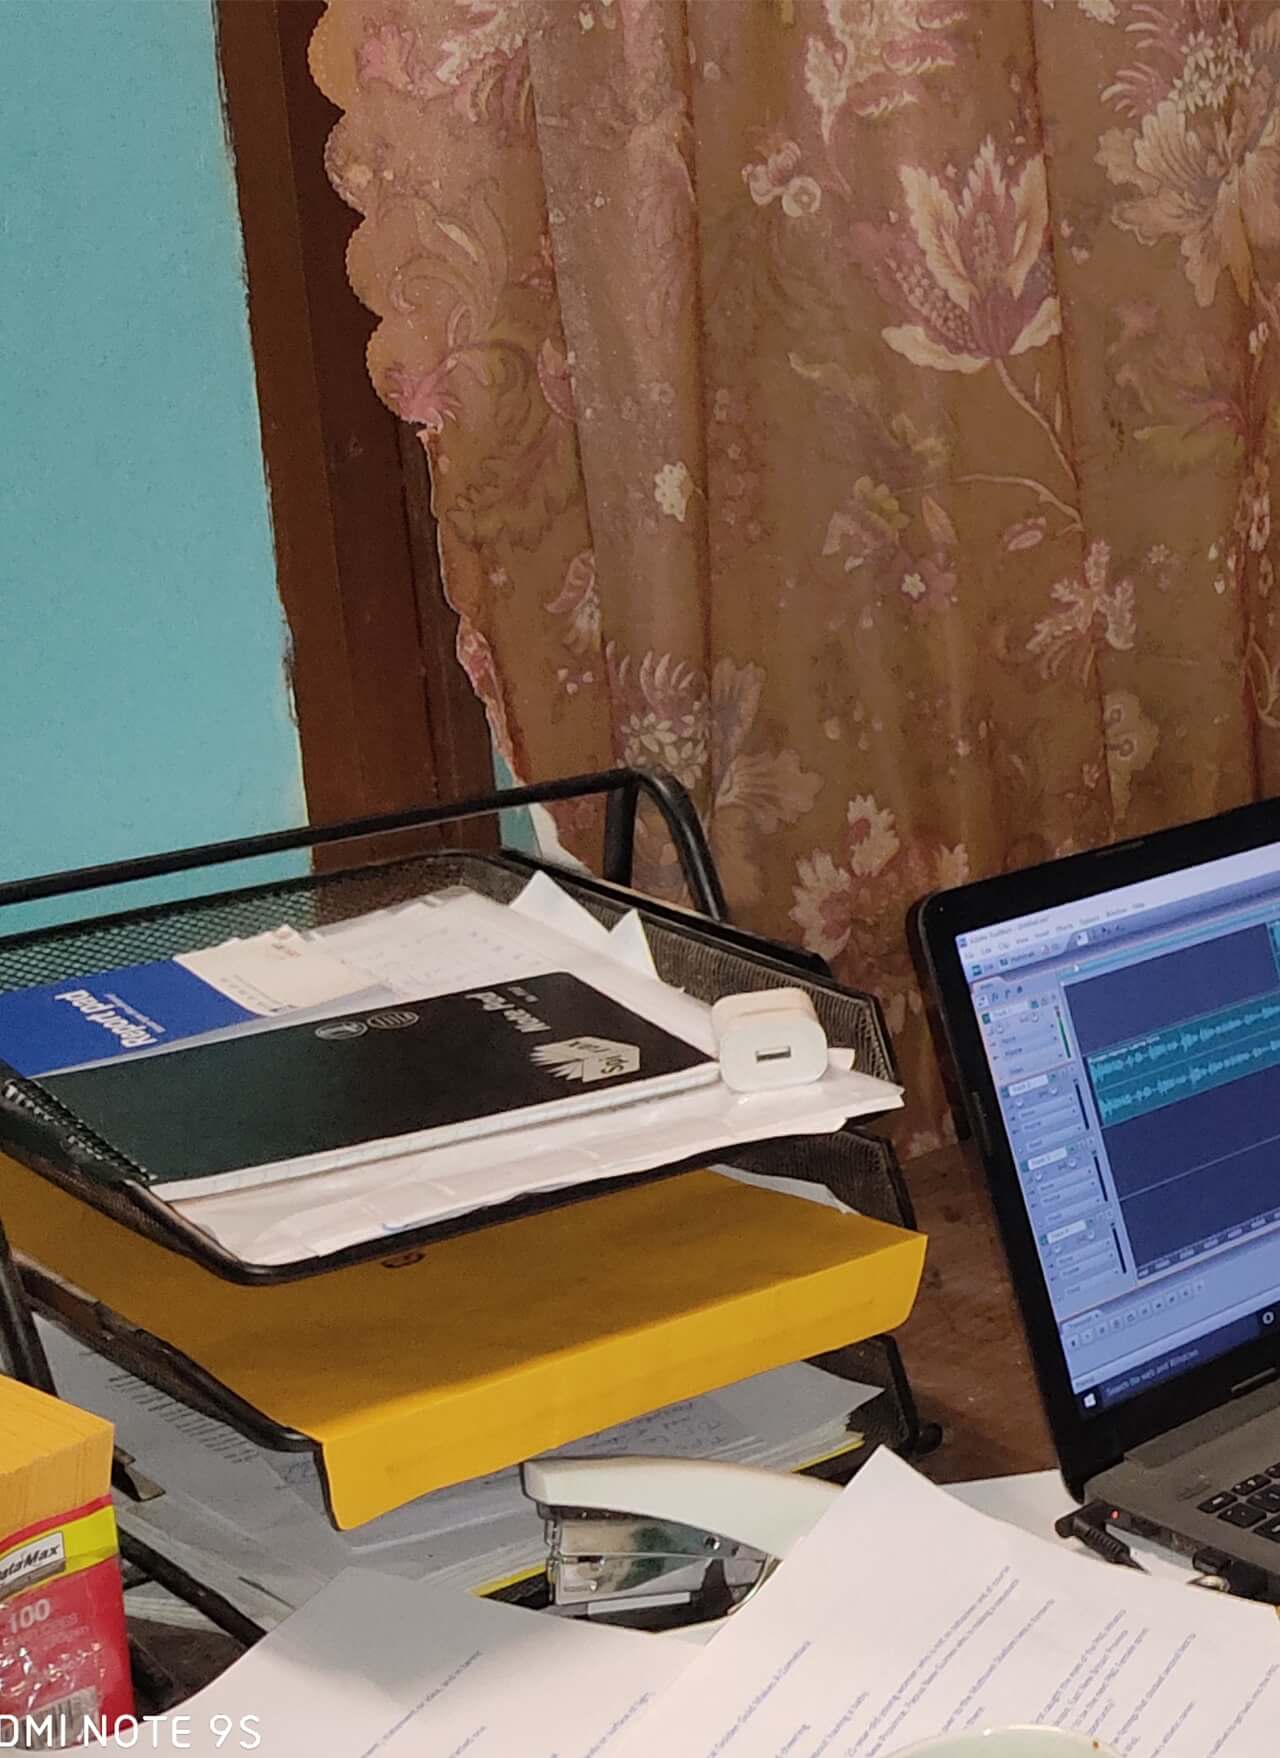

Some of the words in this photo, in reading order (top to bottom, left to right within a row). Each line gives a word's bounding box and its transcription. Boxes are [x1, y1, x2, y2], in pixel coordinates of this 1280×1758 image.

[54, 989, 114, 1014] pad
[86, 1010, 158, 1048] Report
[503, 1008, 551, 1033] Note
[9, 1598, 51, 1634] 100
